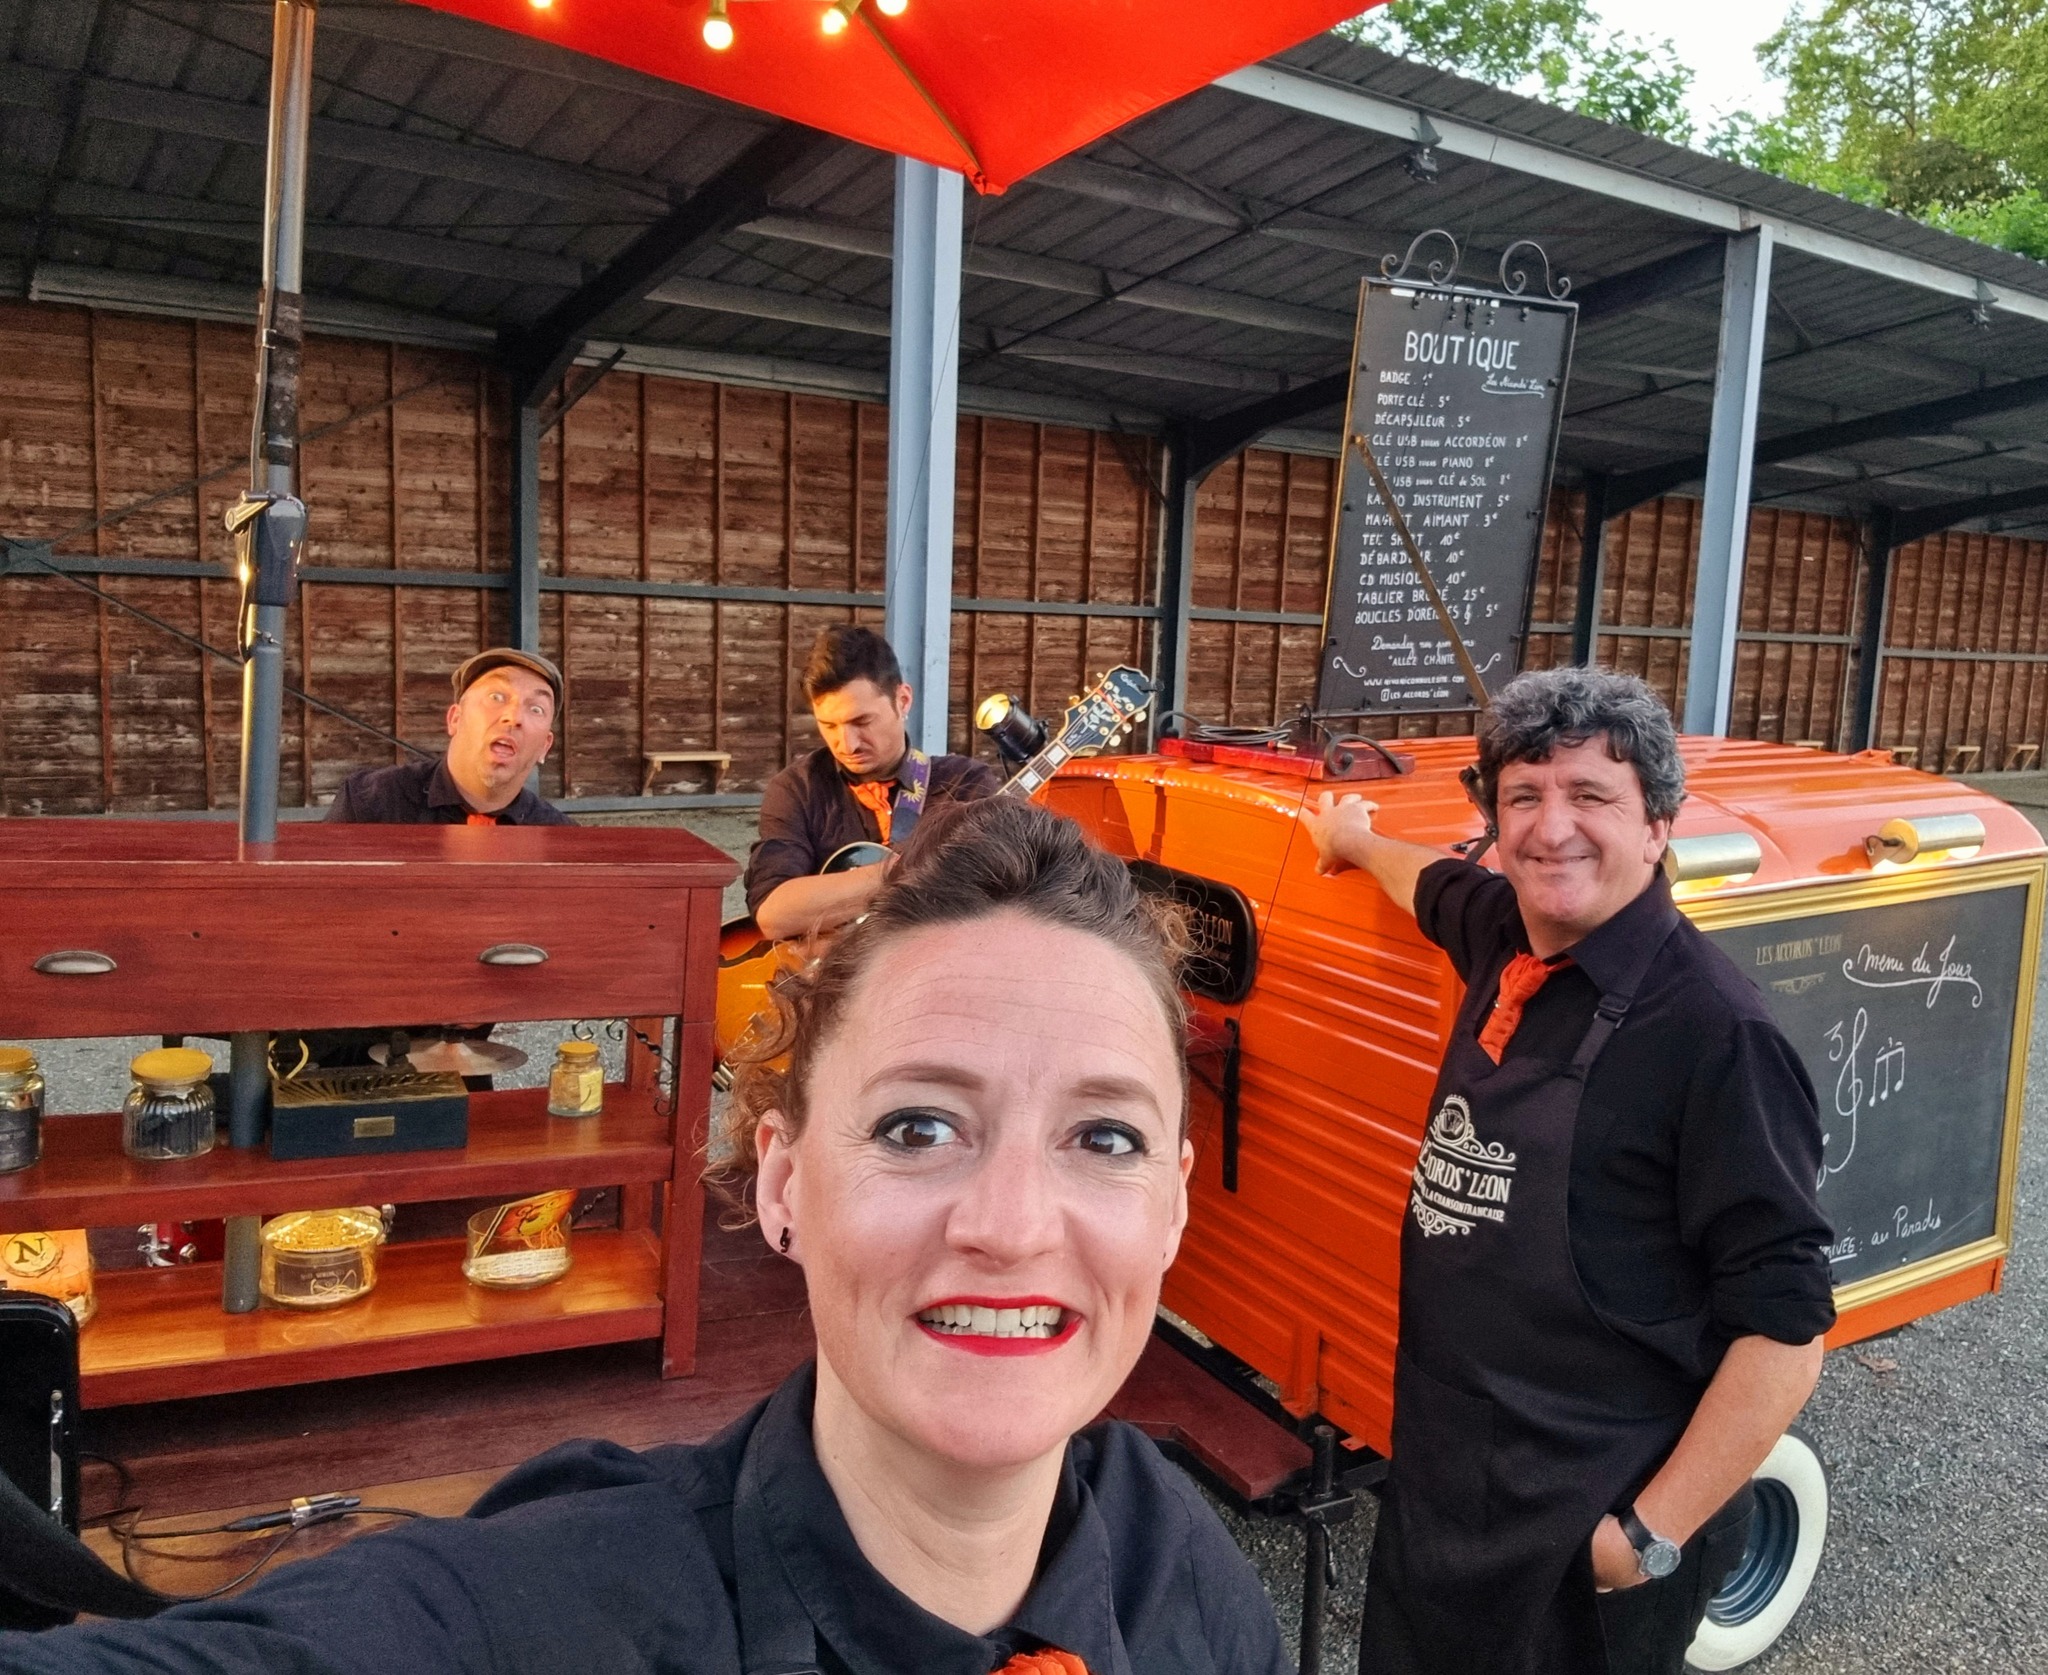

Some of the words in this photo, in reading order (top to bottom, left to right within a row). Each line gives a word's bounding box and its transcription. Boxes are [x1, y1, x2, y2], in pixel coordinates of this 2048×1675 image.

[1404, 330, 1520, 372] BOUTIQUE
[1380, 371, 1411, 385] BADGE
[1377, 393, 1405, 407] PORTE
[1406, 393, 1425, 407] CLÉ
[1438, 395, 1451, 408] 5€
[1457, 416, 1471, 428] 5€
[1372, 432, 1392, 446] CLÉ
[1397, 435, 1417, 447] USB
[1444, 433, 1506, 448] ACCORDÉON
[1374, 452, 1390, 466] LÉ
[1395, 456, 1415, 468] USB
[1442, 457, 1473, 468] PIANO
[1393, 475, 1412, 488] USB
[1438, 471, 1456, 487] CLÉ
[1470, 474, 1487, 487] SOL
[1412, 494, 1484, 509] INSTRUMENT
[1497, 494, 1511, 508] 5€
[1423, 512, 1470, 528] AIMANT
[1483, 512, 1499, 528] 3€
[1440, 531, 1461, 546] 10€
[1359, 549, 1431, 566] DÉBARDR
[1445, 549, 1465, 564] 10€
[1359, 573, 1375, 586] CD
[1445, 570, 1467, 585] 10€
[1356, 590, 1404, 605] TABLIER
[1462, 586, 1486, 601] 25€
[1355, 609, 1401, 625] BOUCLES
[1485, 603, 1499, 618] 5€
[1370, 633, 1415, 660] Demandez
[1756, 945, 1773, 966] LES
[1857, 943, 1904, 973] Menu
[1911, 941, 1931, 974] du
[1926, 934, 1974, 1009] Jour
[1871, 1231, 1890, 1246] au
[1892, 1197, 1942, 1239] Paradis
